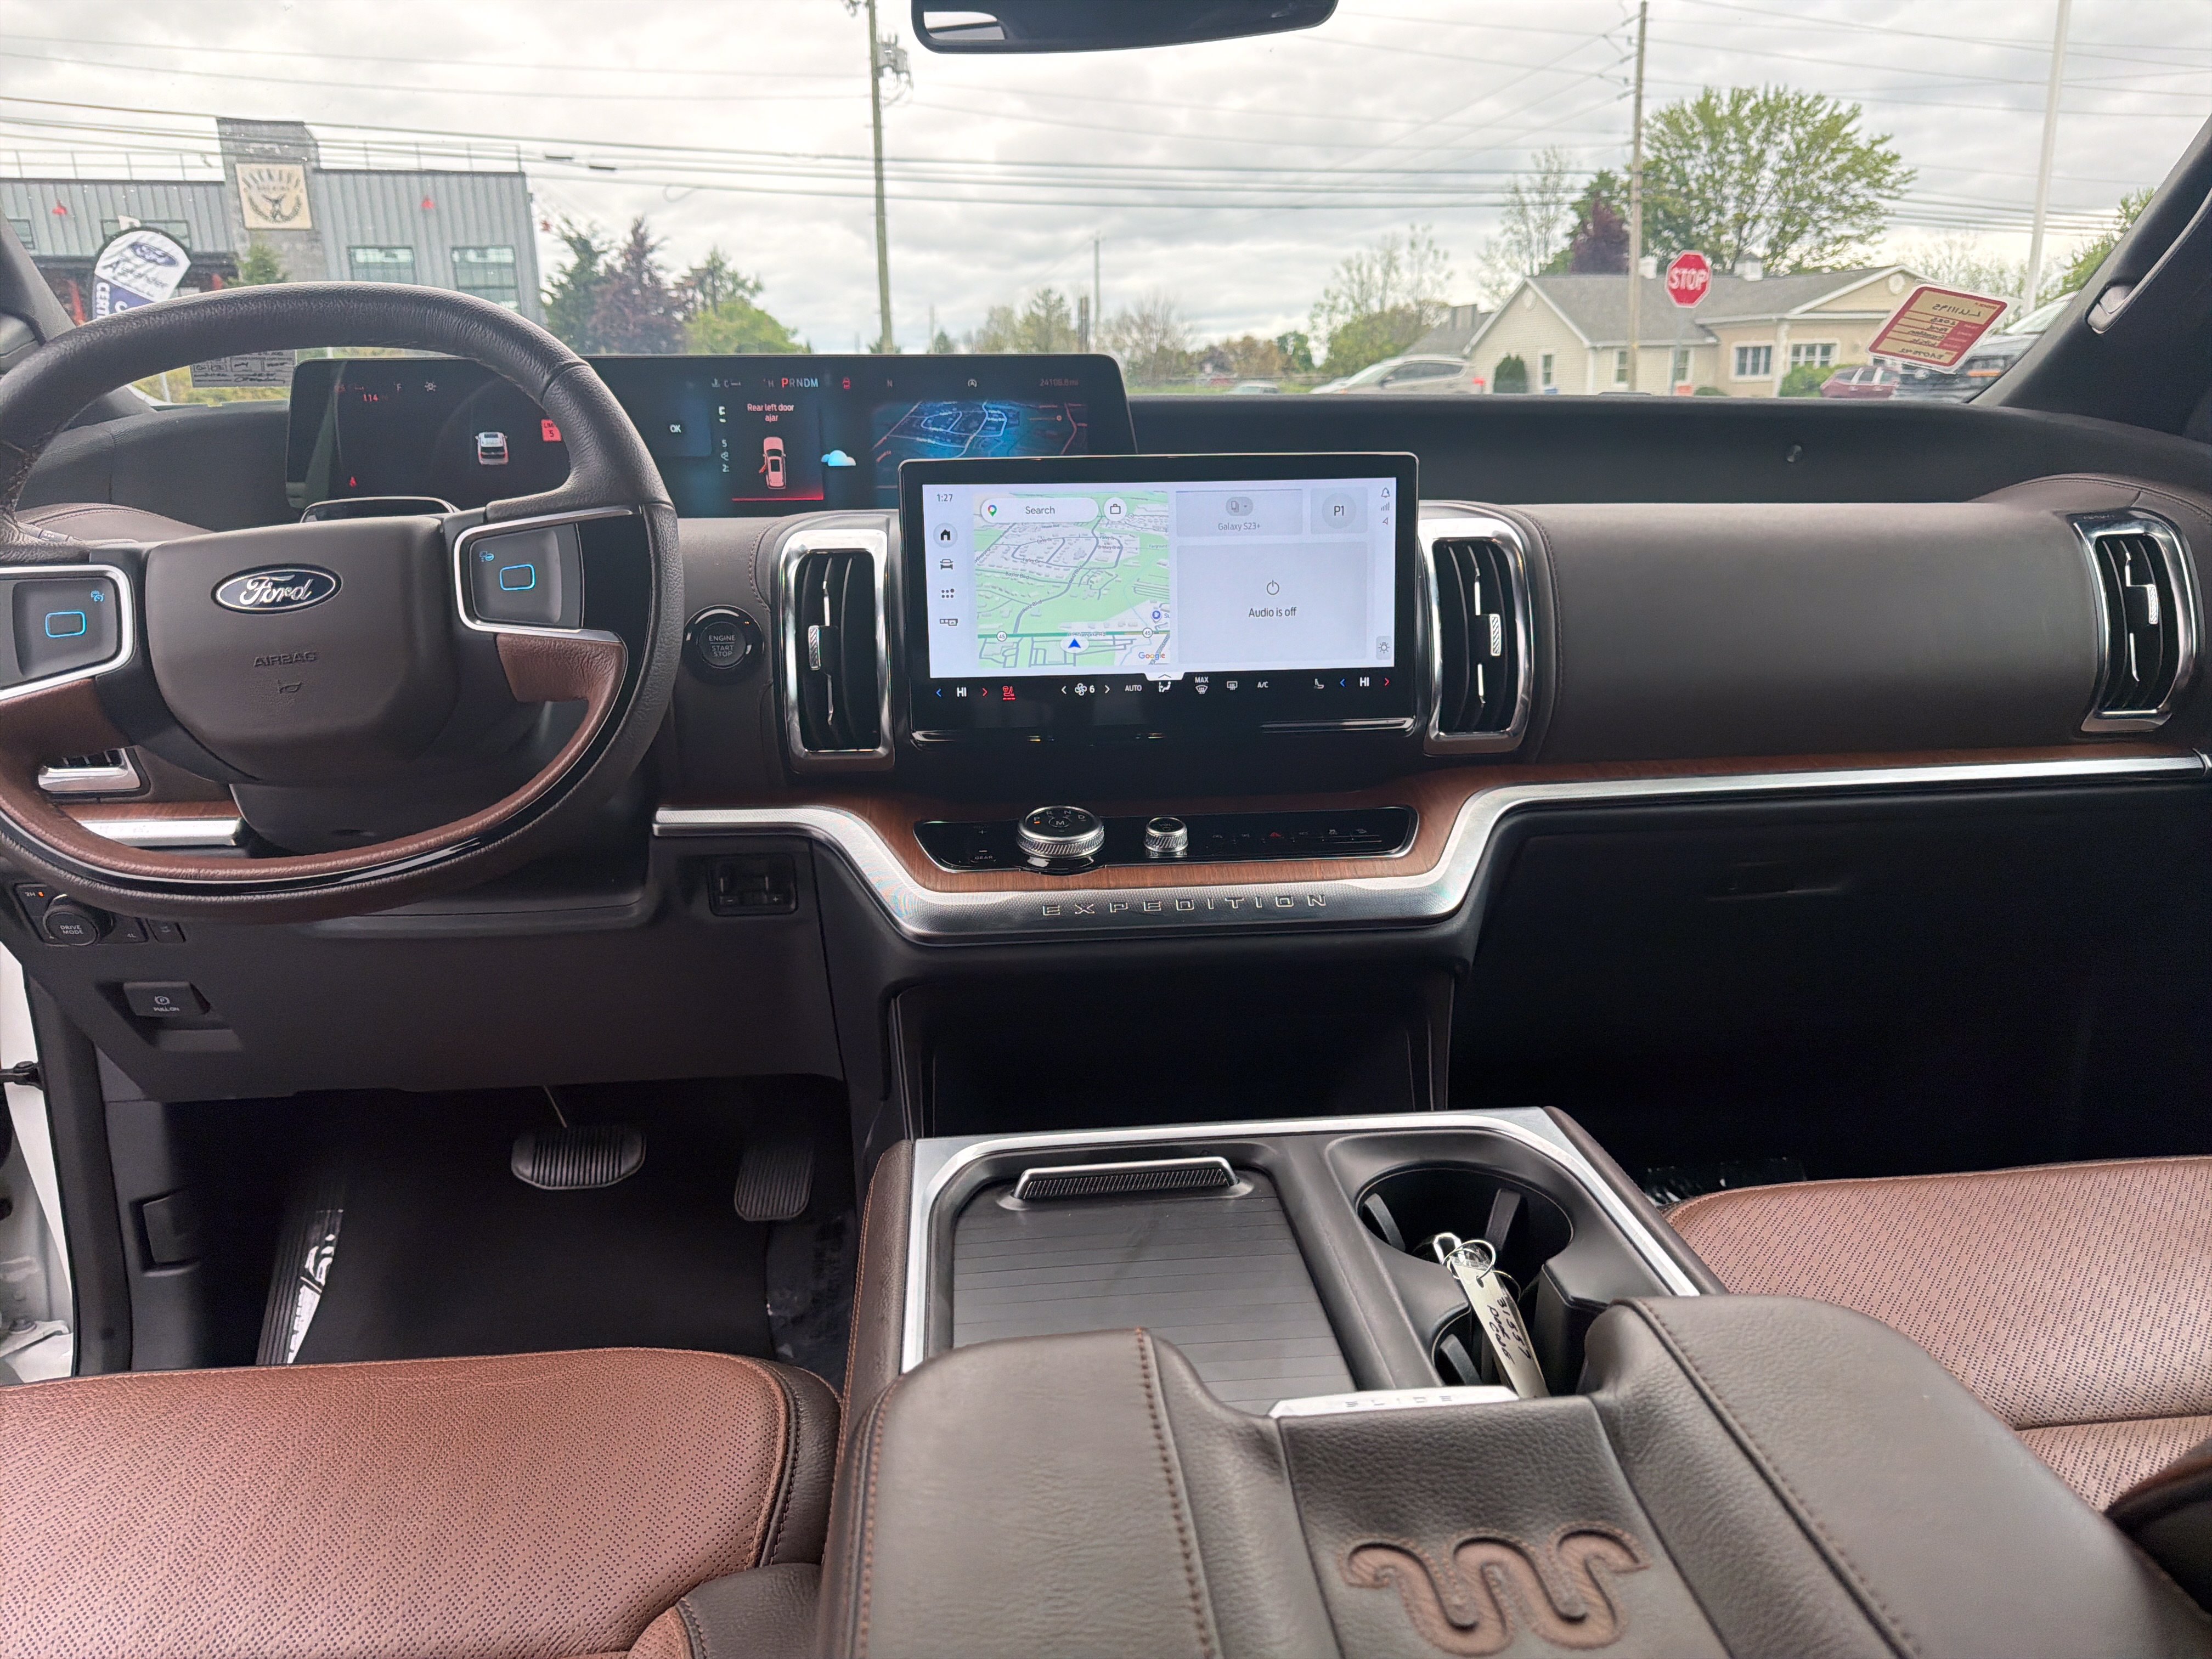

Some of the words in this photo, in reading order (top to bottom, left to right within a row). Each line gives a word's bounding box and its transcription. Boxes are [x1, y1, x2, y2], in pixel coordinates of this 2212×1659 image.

[1669, 267, 1707, 290] STOP
[778, 403, 794, 411] door
[670, 425, 681, 433] OK
[936, 494, 953, 502] 1:27
[1025, 506, 1056, 515] Search
[1334, 506, 1344, 516] P1
[1218, 523, 1242, 531] Galaxy
[1243, 522, 1260, 531] S23+
[240, 574, 314, 606] Ford
[1249, 608, 1274, 618] Audio
[1276, 608, 1283, 617] is
[1284, 606, 1297, 617] off
[253, 651, 318, 667] AIRBAG
[1138, 651, 1165, 661] Google
[1359, 677, 1369, 687] HI
[957, 687, 967, 697] HI
[1089, 685, 1094, 693] 6
[1042, 894, 1326, 916] EXPEDITION
